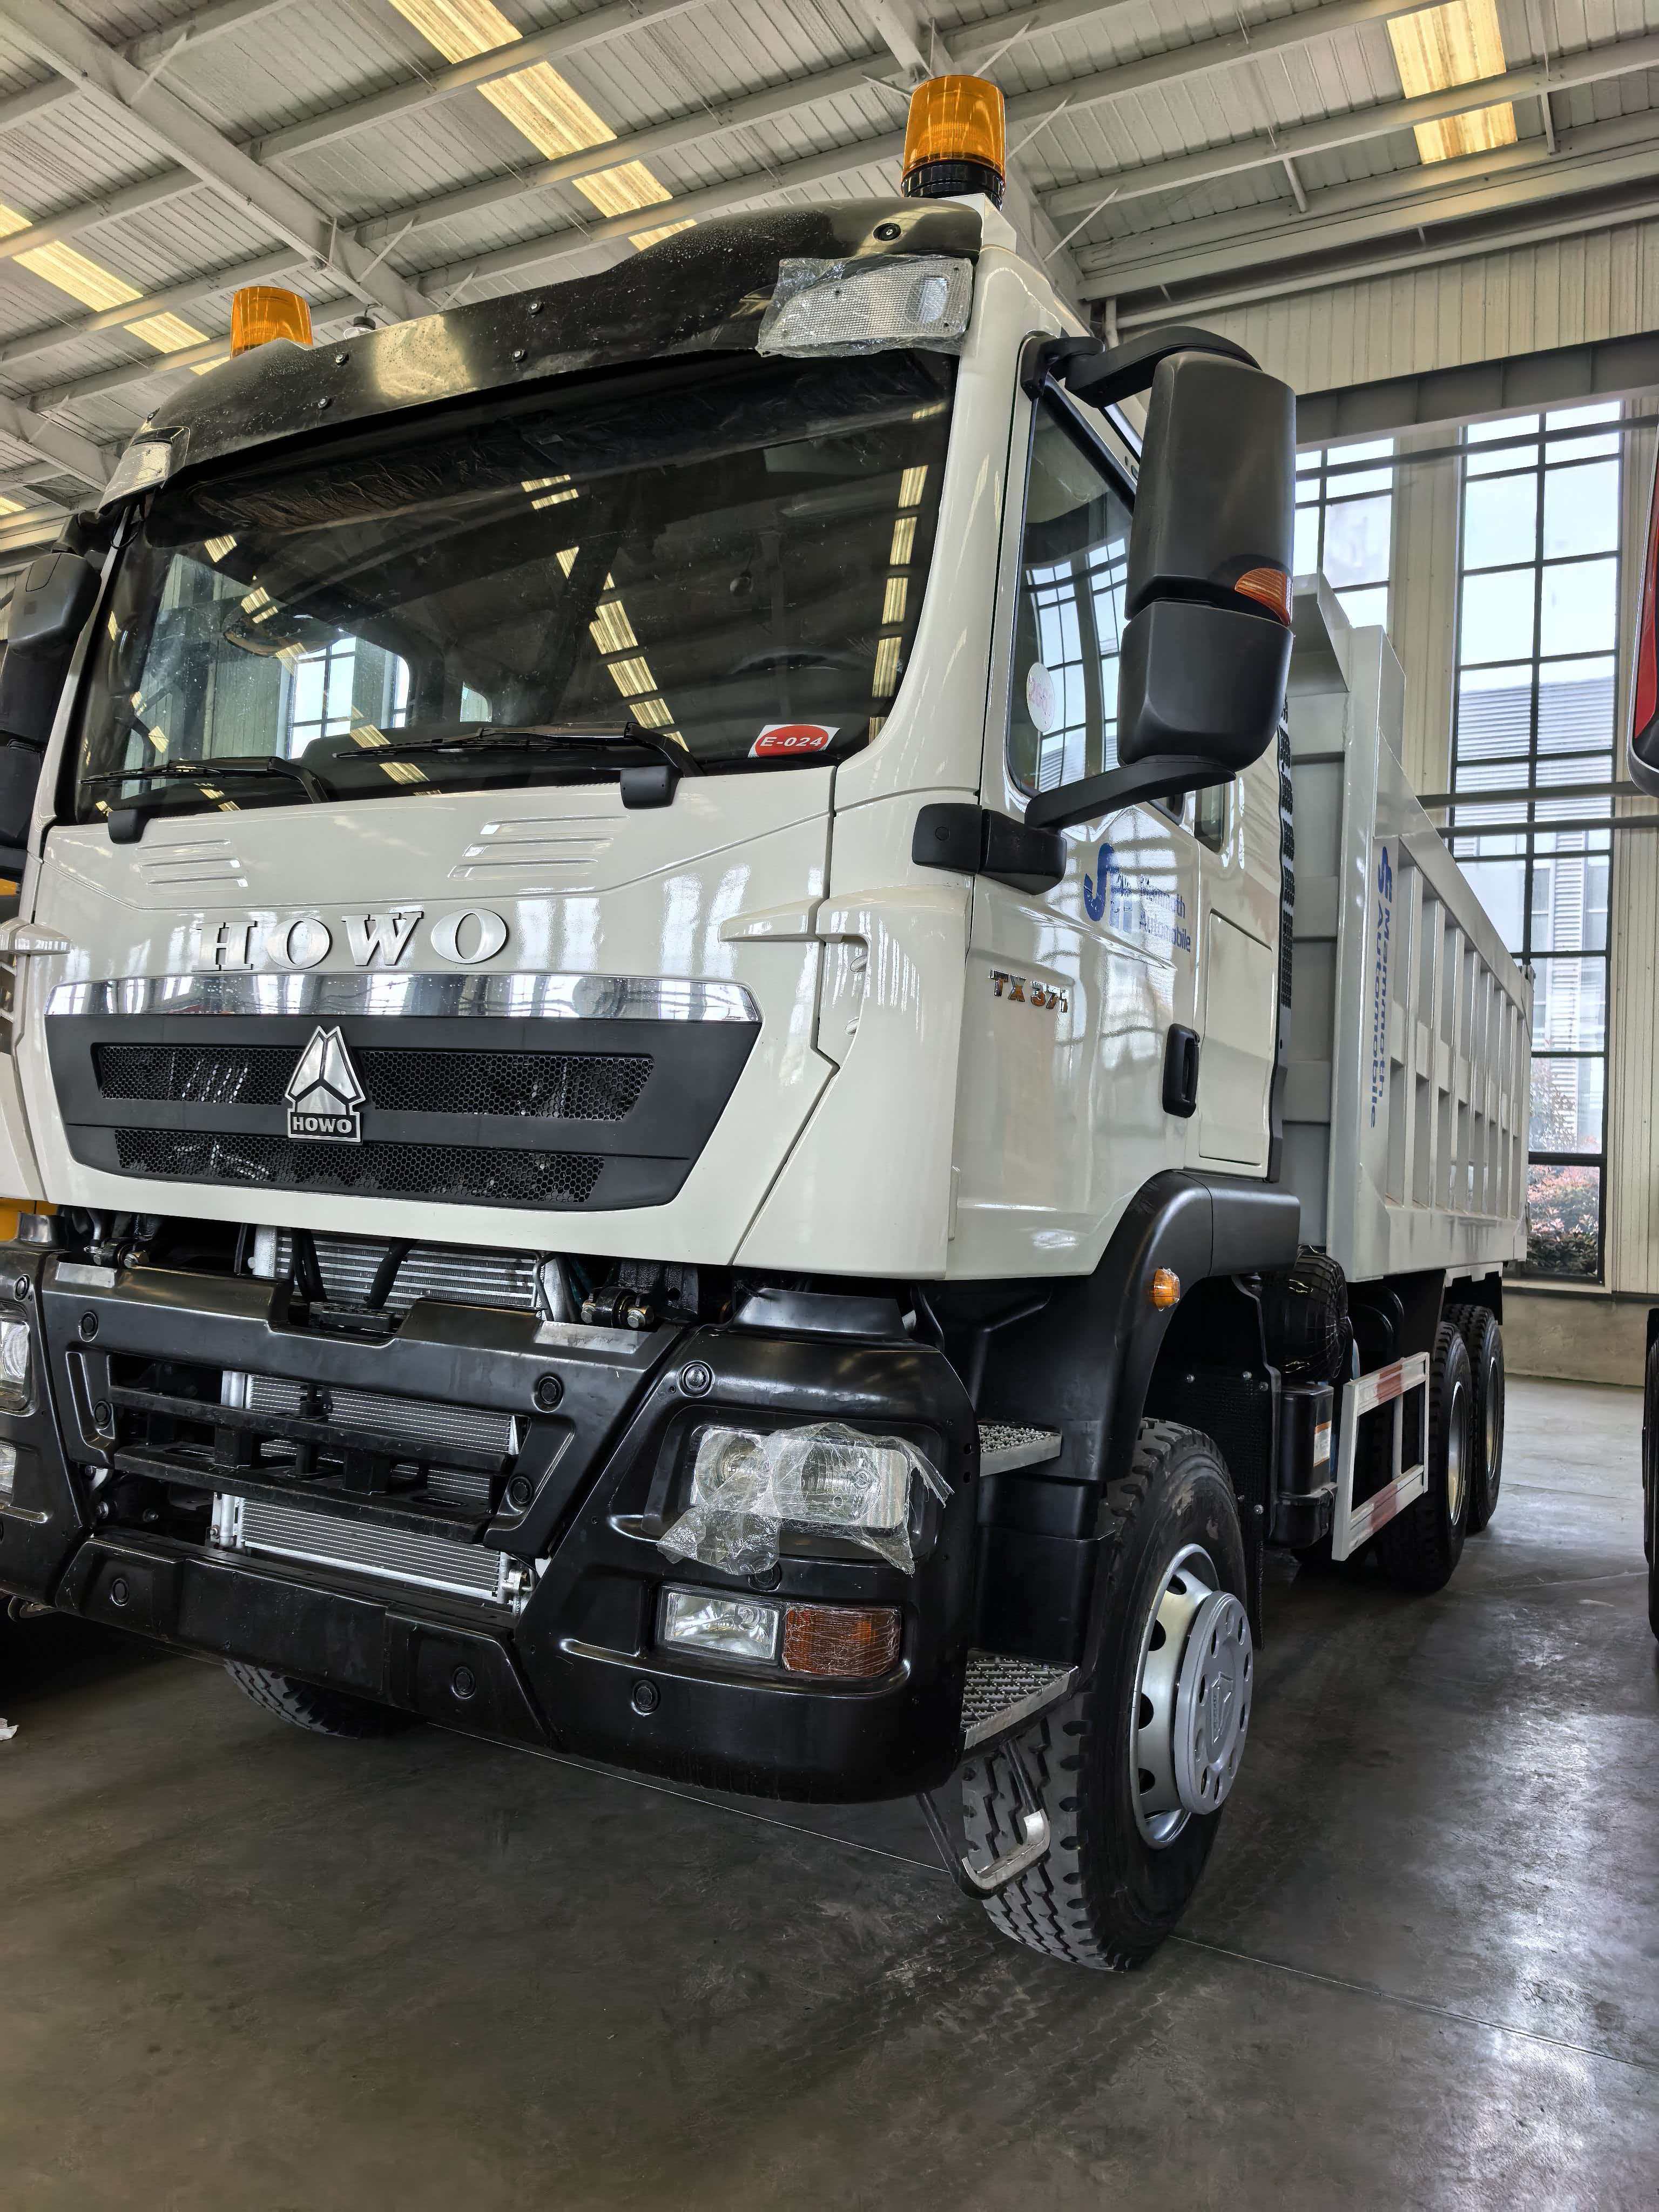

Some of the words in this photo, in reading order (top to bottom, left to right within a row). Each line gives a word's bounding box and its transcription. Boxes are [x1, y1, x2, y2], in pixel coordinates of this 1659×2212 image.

[760, 737, 824, 746] E-024
[192, 908, 509, 972] HOWO
[989, 969, 1027, 1002] TX
[1378, 907, 1391, 1097] Mammoth
[1371, 899, 1383, 1128] Automobile
[292, 1117, 353, 1134] HOWO
